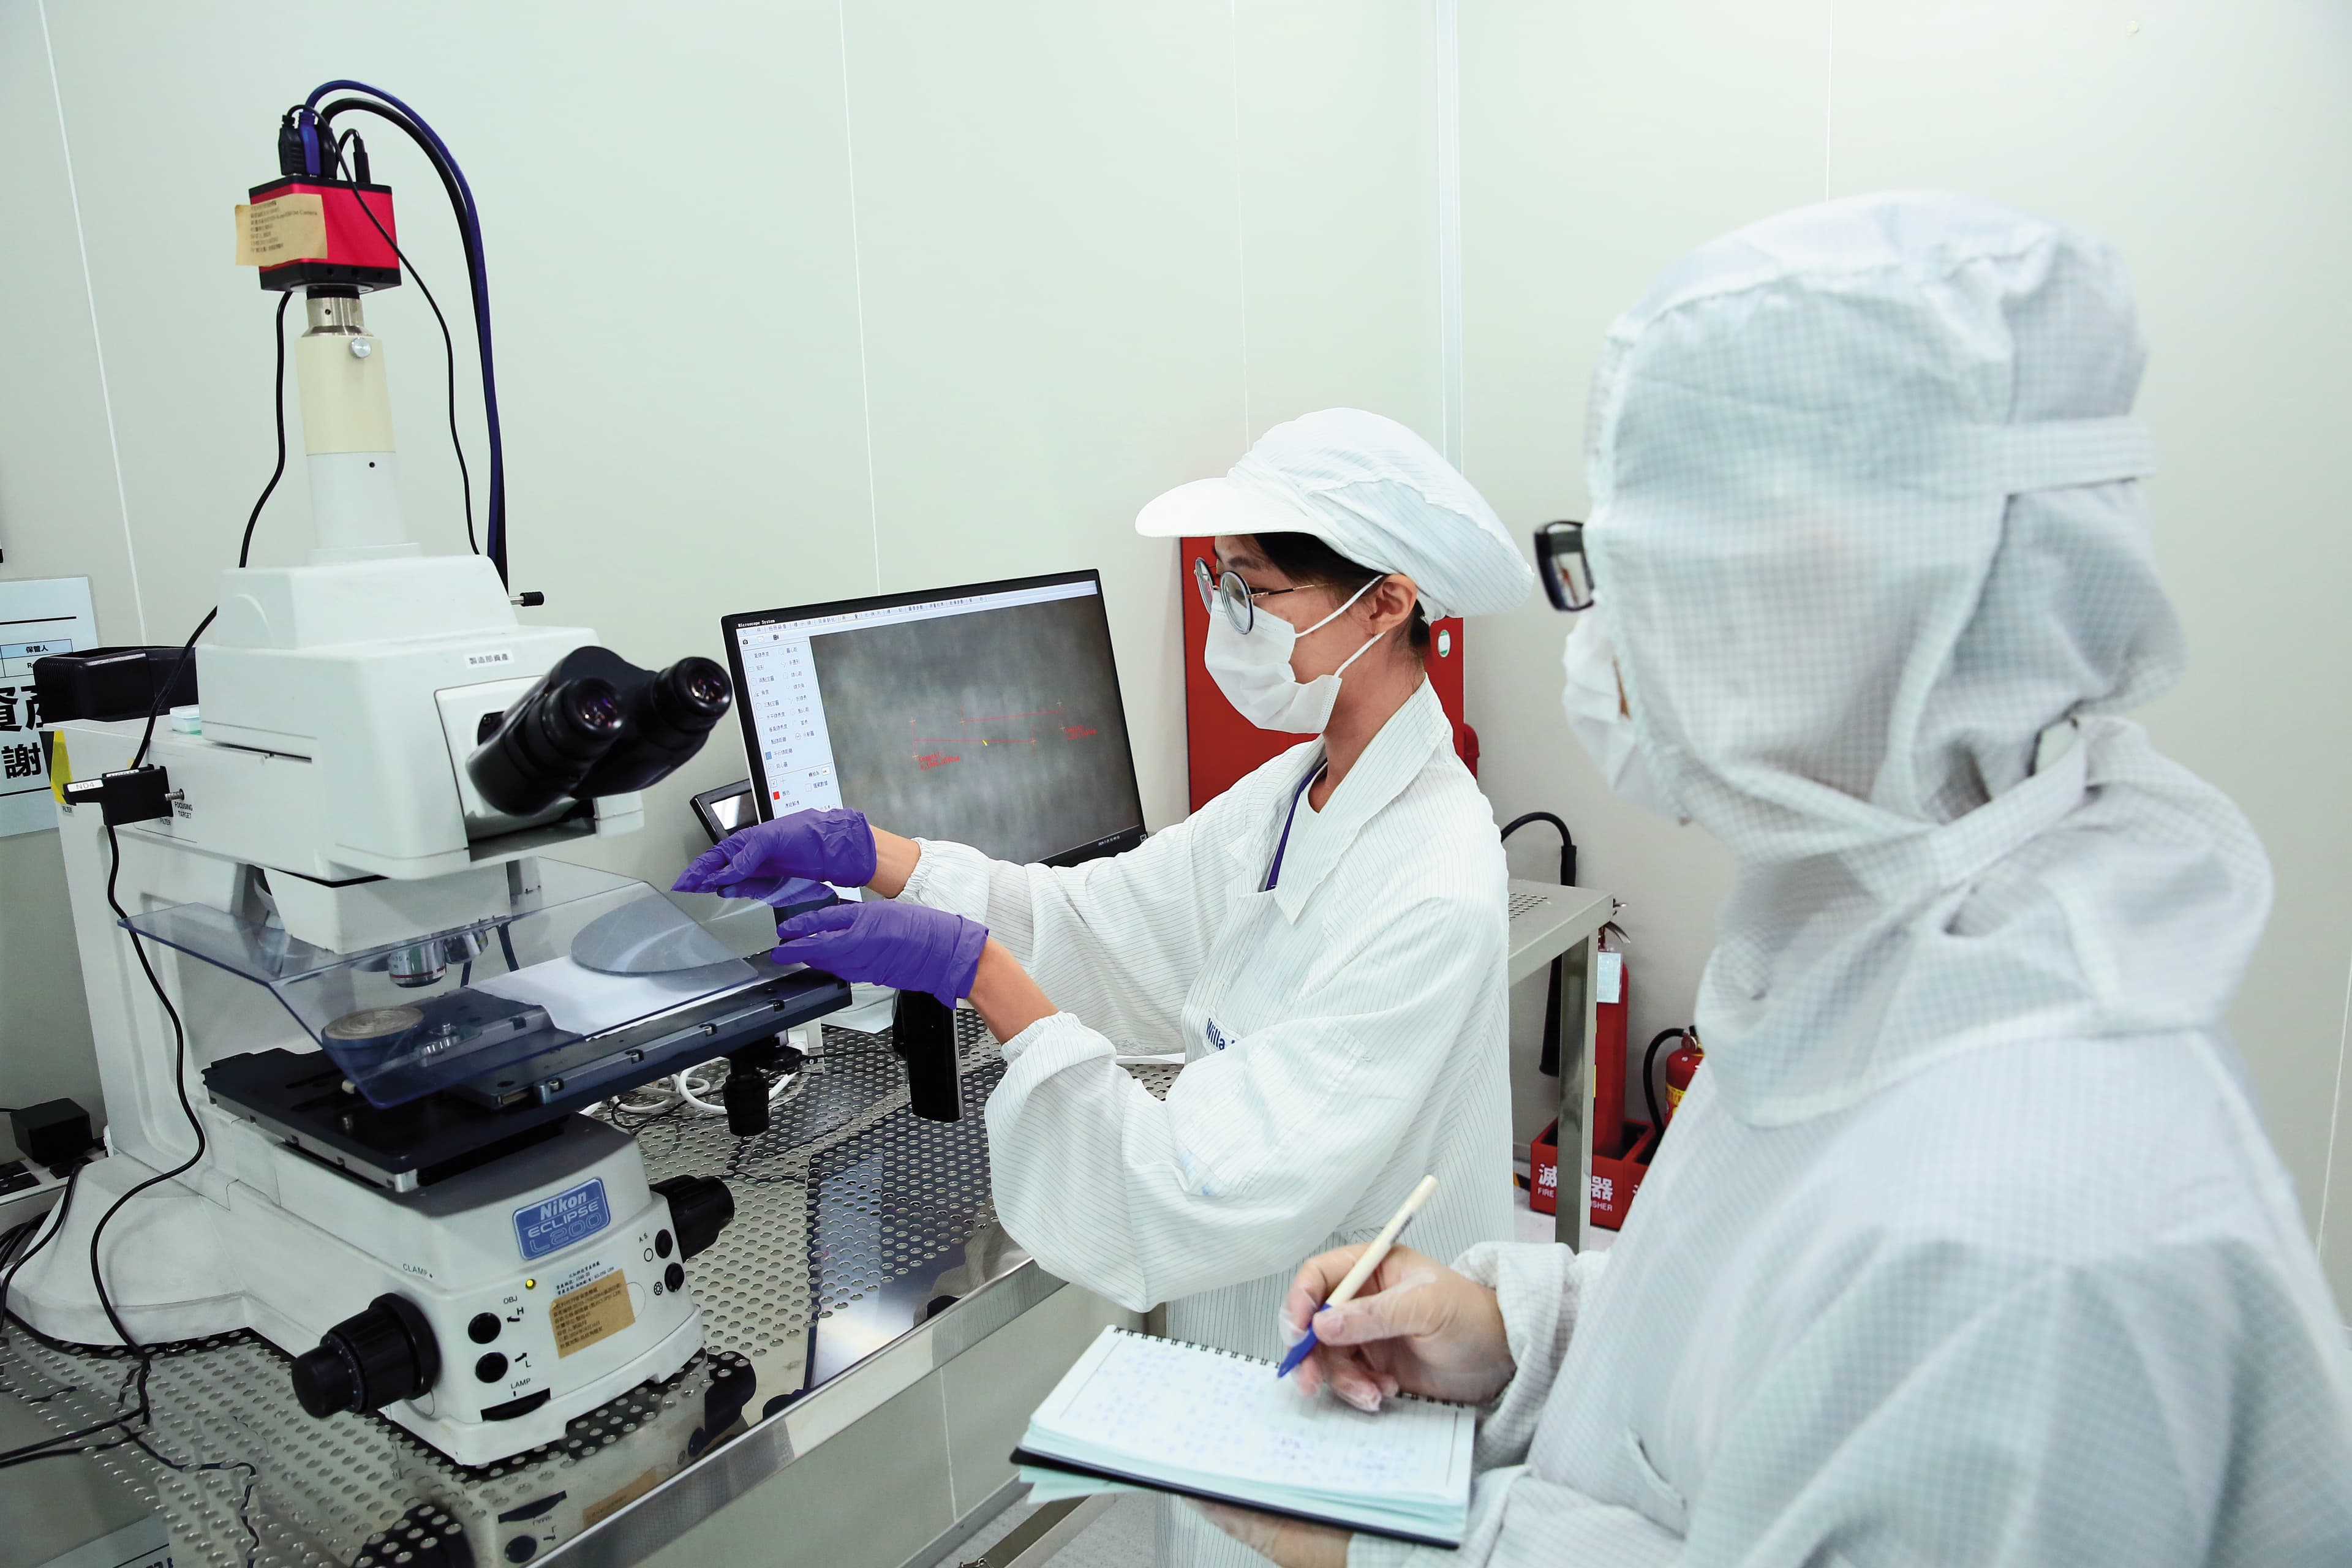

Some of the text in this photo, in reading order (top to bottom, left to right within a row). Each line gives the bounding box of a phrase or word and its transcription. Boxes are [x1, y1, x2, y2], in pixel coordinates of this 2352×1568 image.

[26, 645, 48, 654] 保管人
[1, 742, 42, 779] 謝
[175, 801, 193, 812] FOCUSING
[178, 810, 192, 819] TARGET
[1537, 1187, 1554, 1198] FIRE
[540, 1191, 587, 1221] Nikon
[528, 1200, 599, 1238] ECLIPSE
[530, 1212, 601, 1253] L200
[402, 1264, 428, 1275] CLAMP
[503, 1295, 518, 1304] OBJ
[510, 1378, 531, 1389] LAMP
